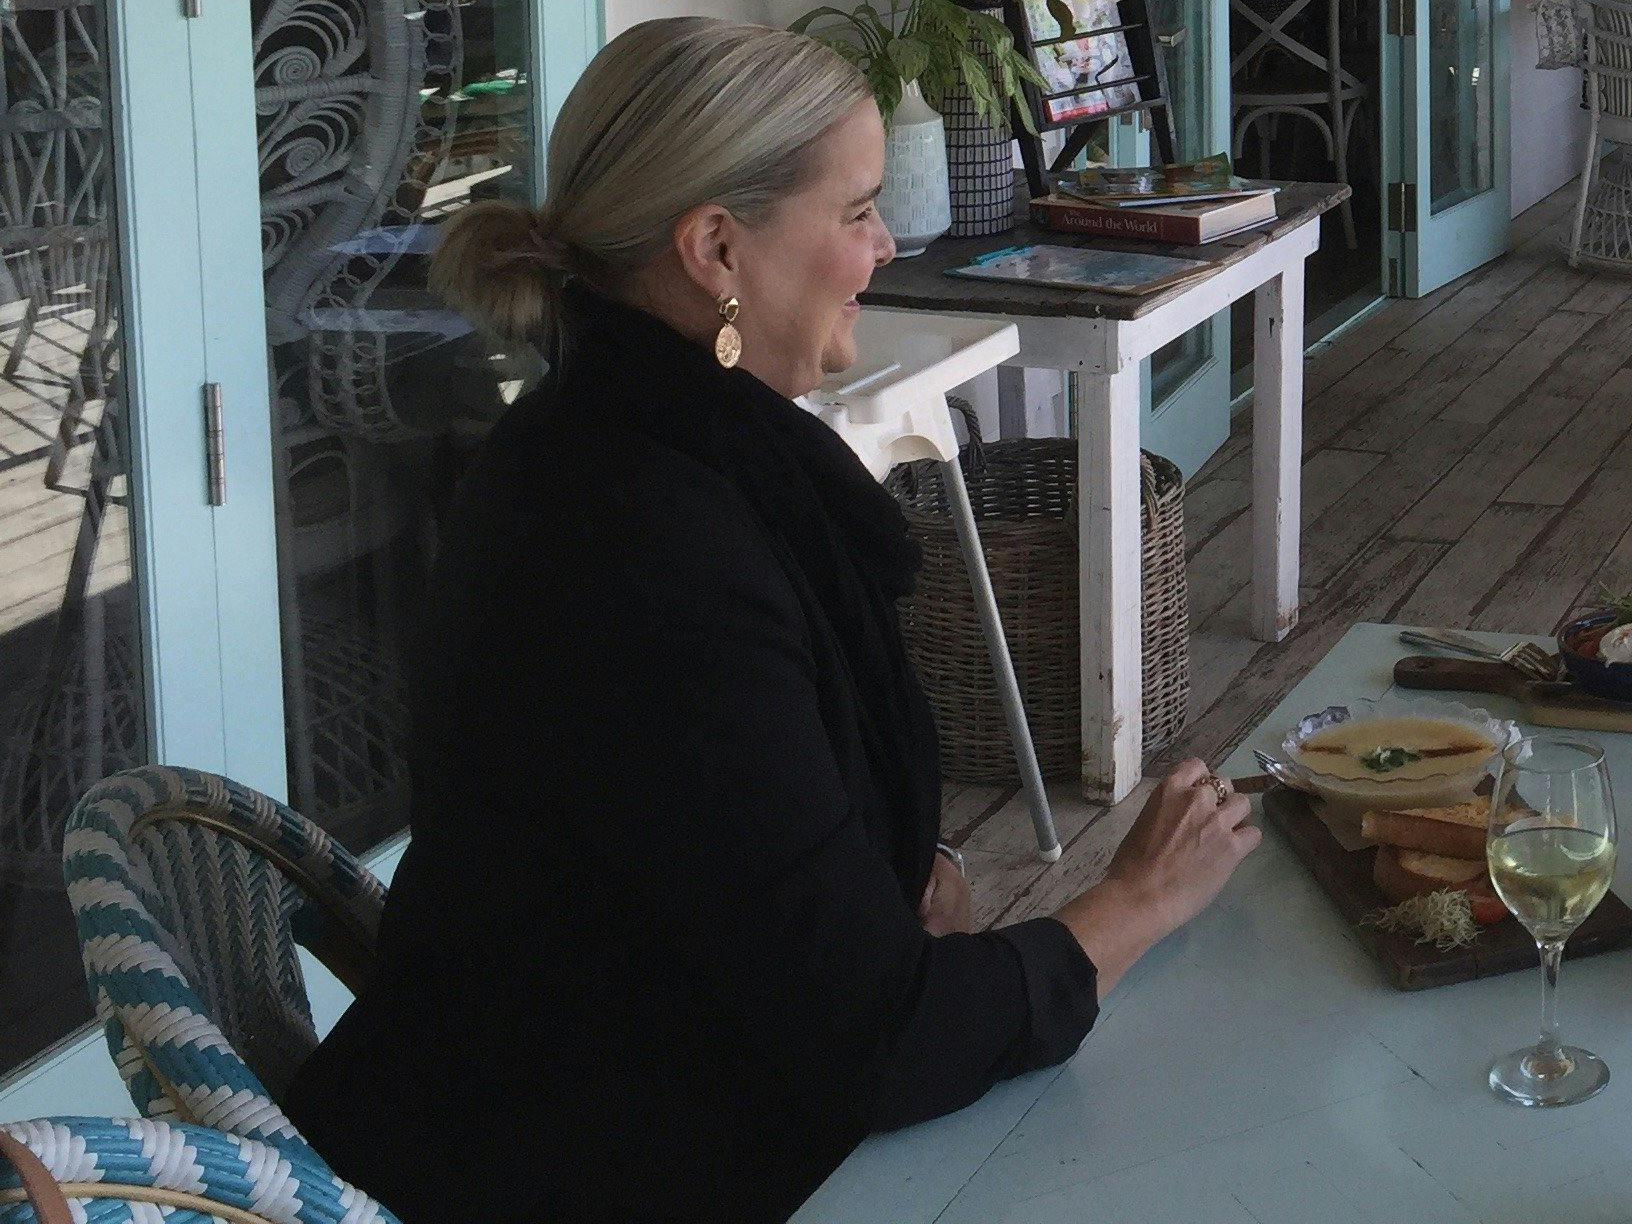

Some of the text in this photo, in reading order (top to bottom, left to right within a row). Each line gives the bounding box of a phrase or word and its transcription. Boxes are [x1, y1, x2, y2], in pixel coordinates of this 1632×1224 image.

[1063, 214, 1158, 233] Around the World
